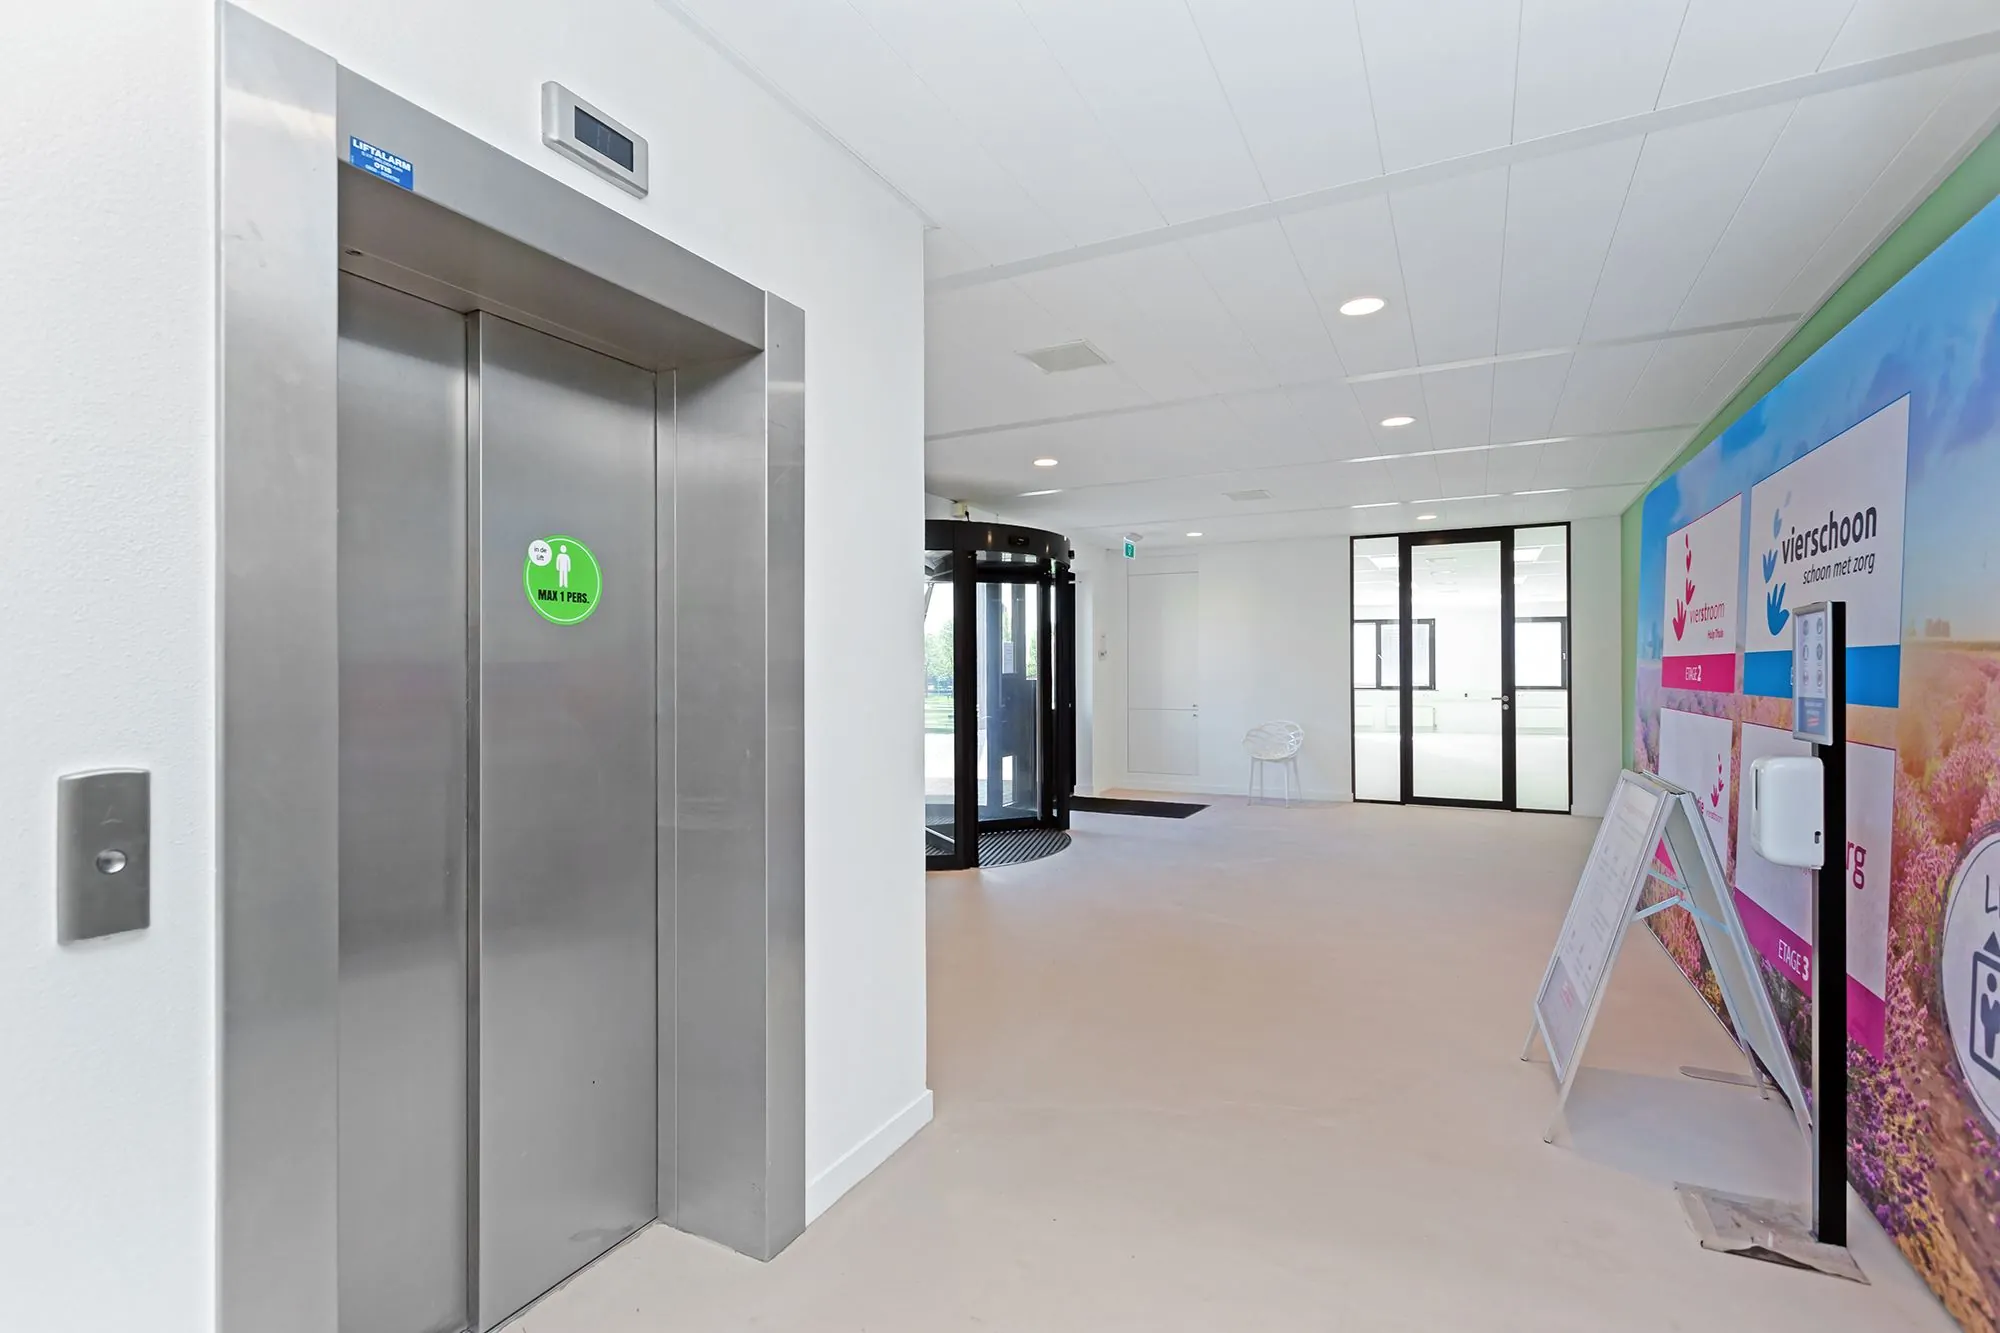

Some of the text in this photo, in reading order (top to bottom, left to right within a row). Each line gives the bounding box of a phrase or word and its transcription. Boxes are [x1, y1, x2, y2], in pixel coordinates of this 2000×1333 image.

[352, 138, 412, 172] LIFTALARM
[1782, 506, 1877, 565] vierschoon
[1803, 552, 1876, 584] schoon met zorg
[538, 589, 590, 604] MAX 1 PERS.
[1690, 602, 1725, 624] vierstroom
[1685, 664, 1702, 682] ETAGE 2
[1778, 938, 1810, 982] ETAGE 3
